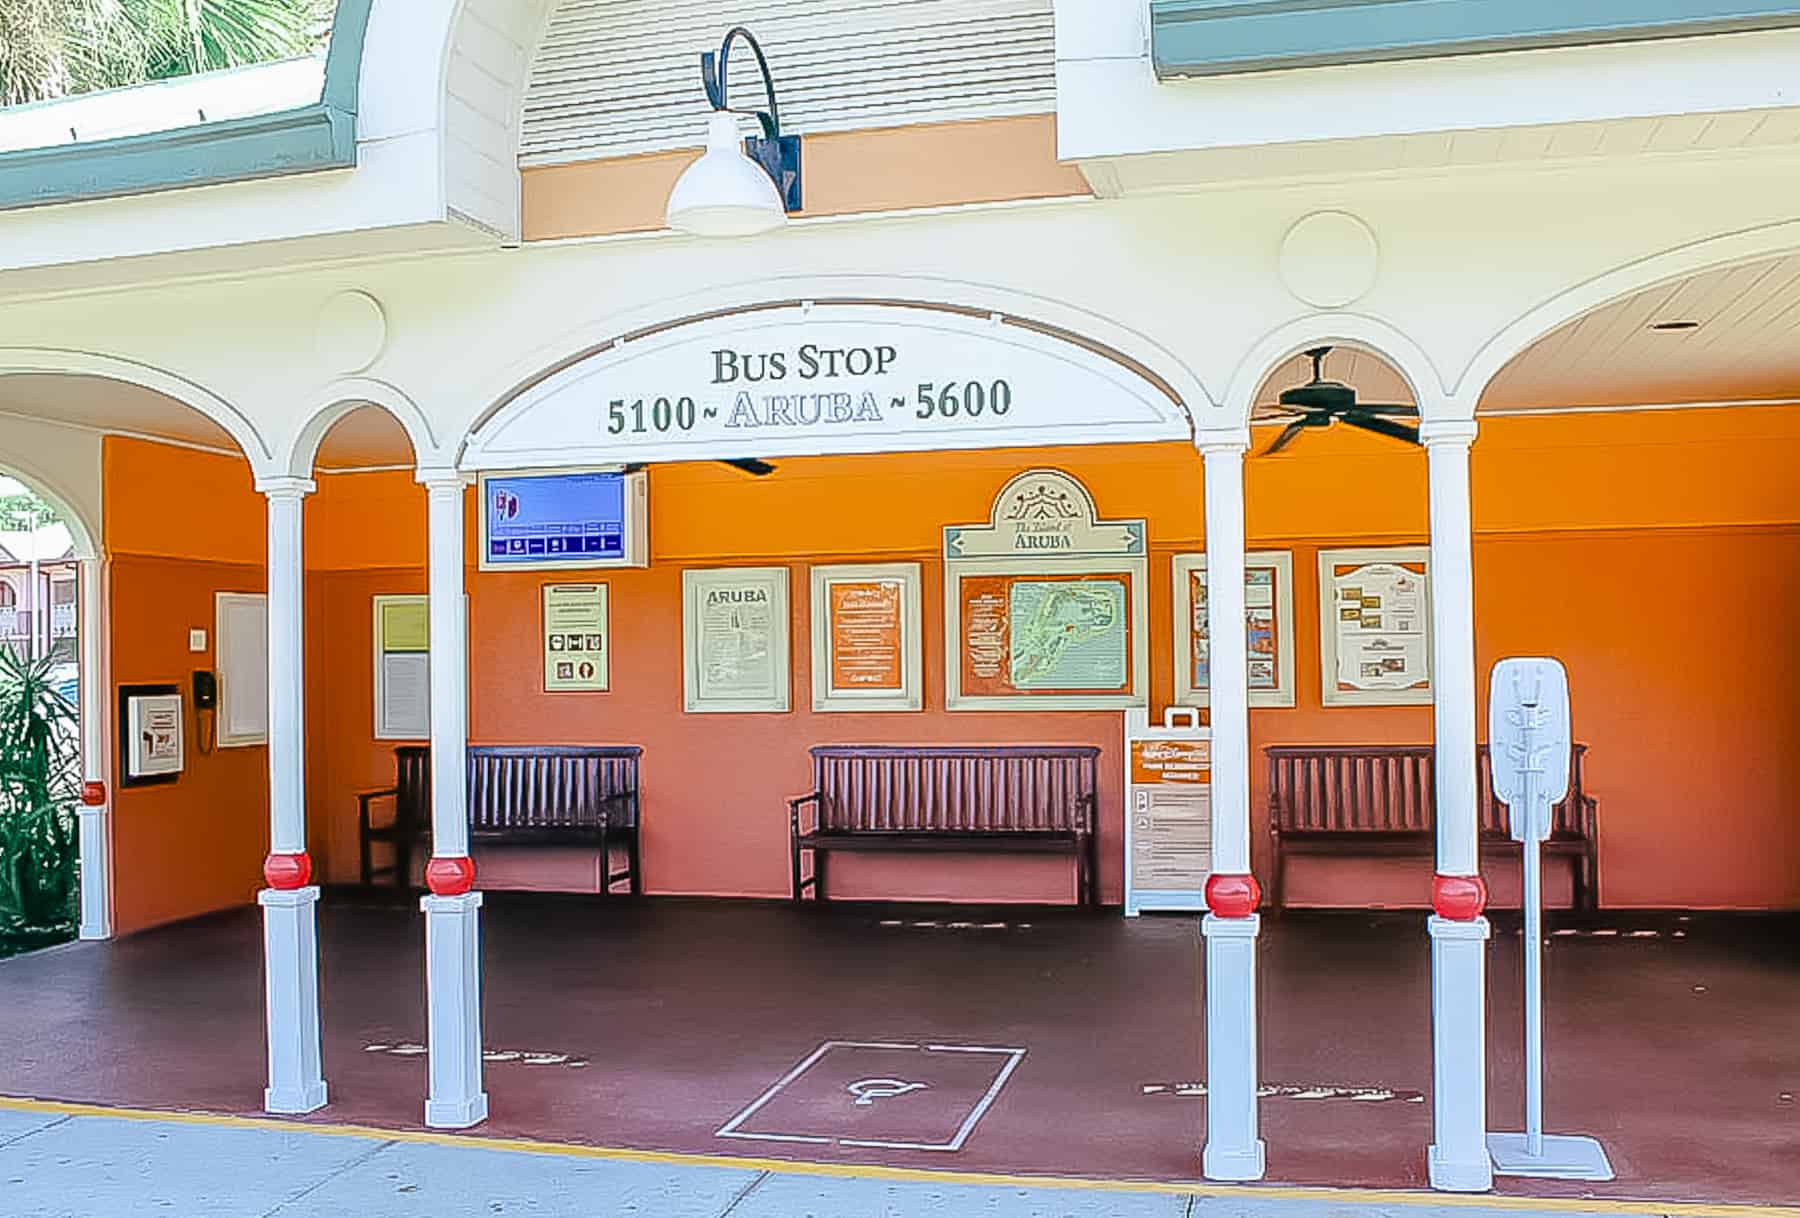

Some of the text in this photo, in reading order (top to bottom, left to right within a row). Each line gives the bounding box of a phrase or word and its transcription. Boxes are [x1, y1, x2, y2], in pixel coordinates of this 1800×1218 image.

[607, 396, 696, 434] 5100
[724, 390, 883, 429] ARUBA
[915, 379, 1012, 419] 5600
[1015, 534, 1071, 549] ARUBA
[707, 588, 767, 603] ARUBA
